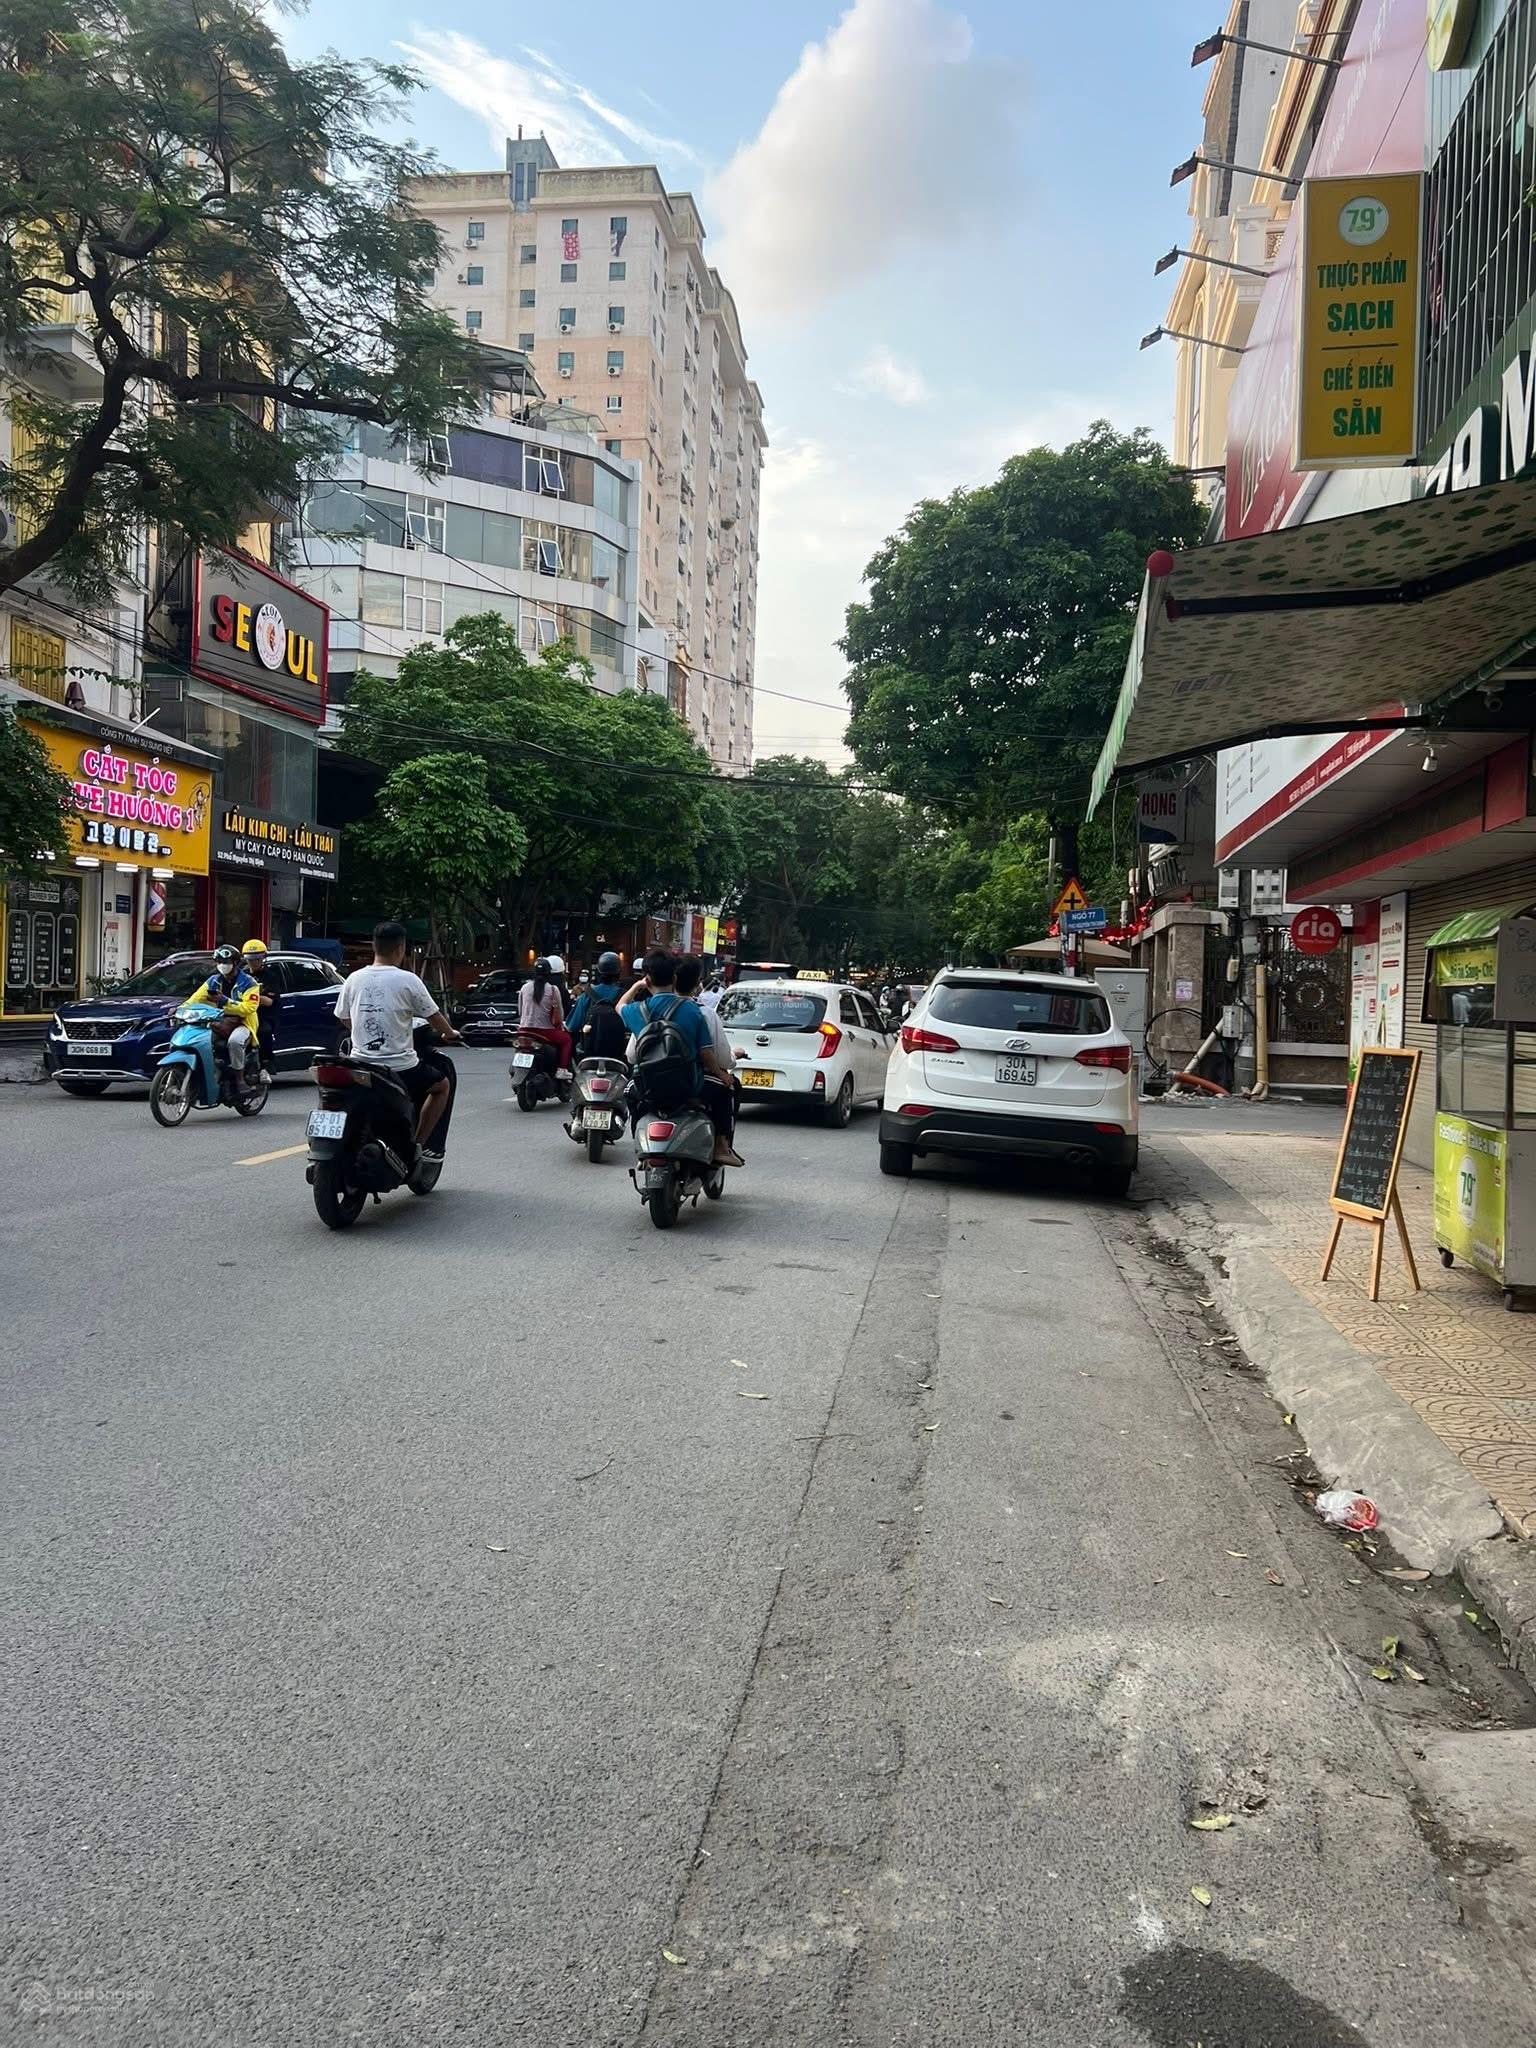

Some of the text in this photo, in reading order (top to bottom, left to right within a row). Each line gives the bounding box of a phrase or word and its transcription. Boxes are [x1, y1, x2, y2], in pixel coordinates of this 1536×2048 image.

[1317, 252, 1407, 291] THỰC PHẨM
[1327, 300, 1393, 336] SẠCH
[1323, 357, 1393, 391] CHẾ BIẾN
[1333, 398, 1381, 436] SẴN
[212, 594, 318, 684] SEOUL
[134, 757, 177, 796] TÓC
[108, 791, 182, 829] HƯƠNG
[186, 808, 194, 832] 1
[1142, 792, 1177, 821] HỌNG
[247, 842, 260, 854] CAY
[261, 844, 266, 854] 7
[248, 818, 268, 839] KIM
[270, 824, 287, 843] CHI
[314, 832, 333, 853] THÁI
[1298, 913, 1336, 937] ria
[801, 971, 821, 979] TAXI
[998, 1068, 1035, 1083] 169.45
[1006, 1056, 1027, 1070] 30A
